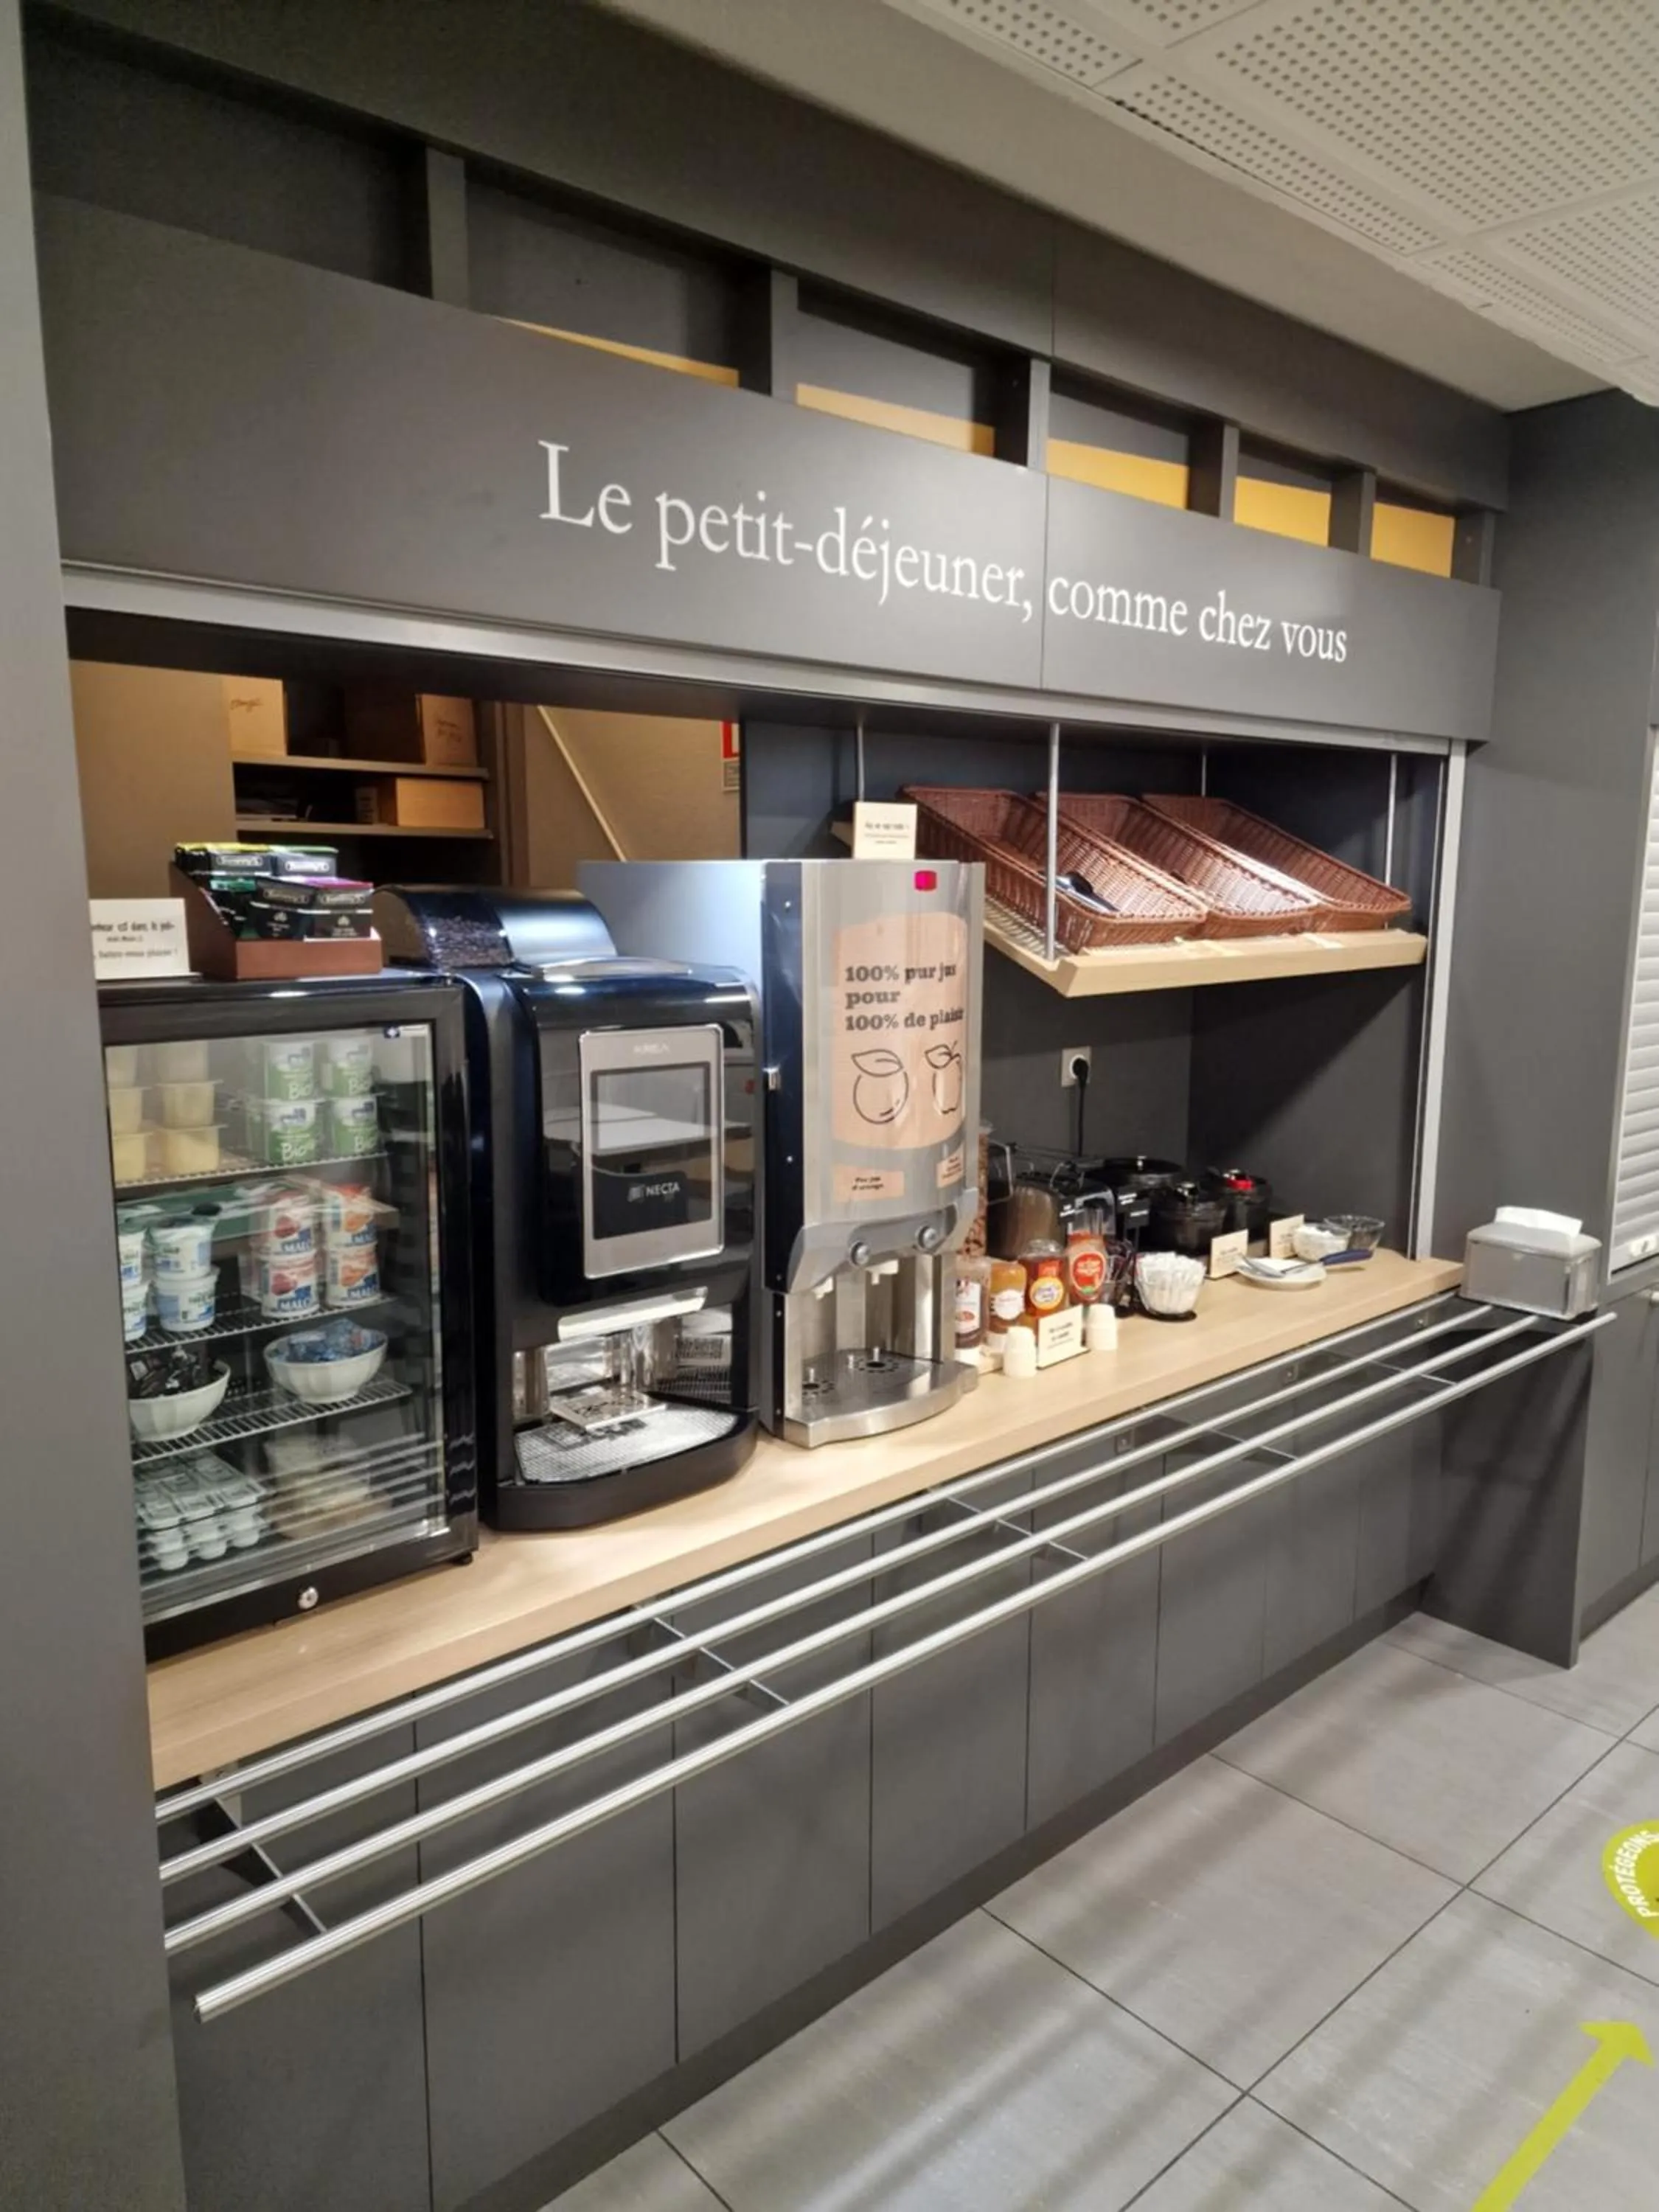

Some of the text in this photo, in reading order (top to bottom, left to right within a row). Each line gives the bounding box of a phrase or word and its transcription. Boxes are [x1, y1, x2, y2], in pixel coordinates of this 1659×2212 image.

[538, 439, 1348, 663] Le petit-déjeuner, comme chez vous
[845, 965, 900, 981] 100%
[904, 966, 936, 984] pur
[845, 990, 900, 1009] pour
[845, 1014, 899, 1031] 100%
[904, 1012, 926, 1028] de
[646, 1181, 681, 1197] NECTA
